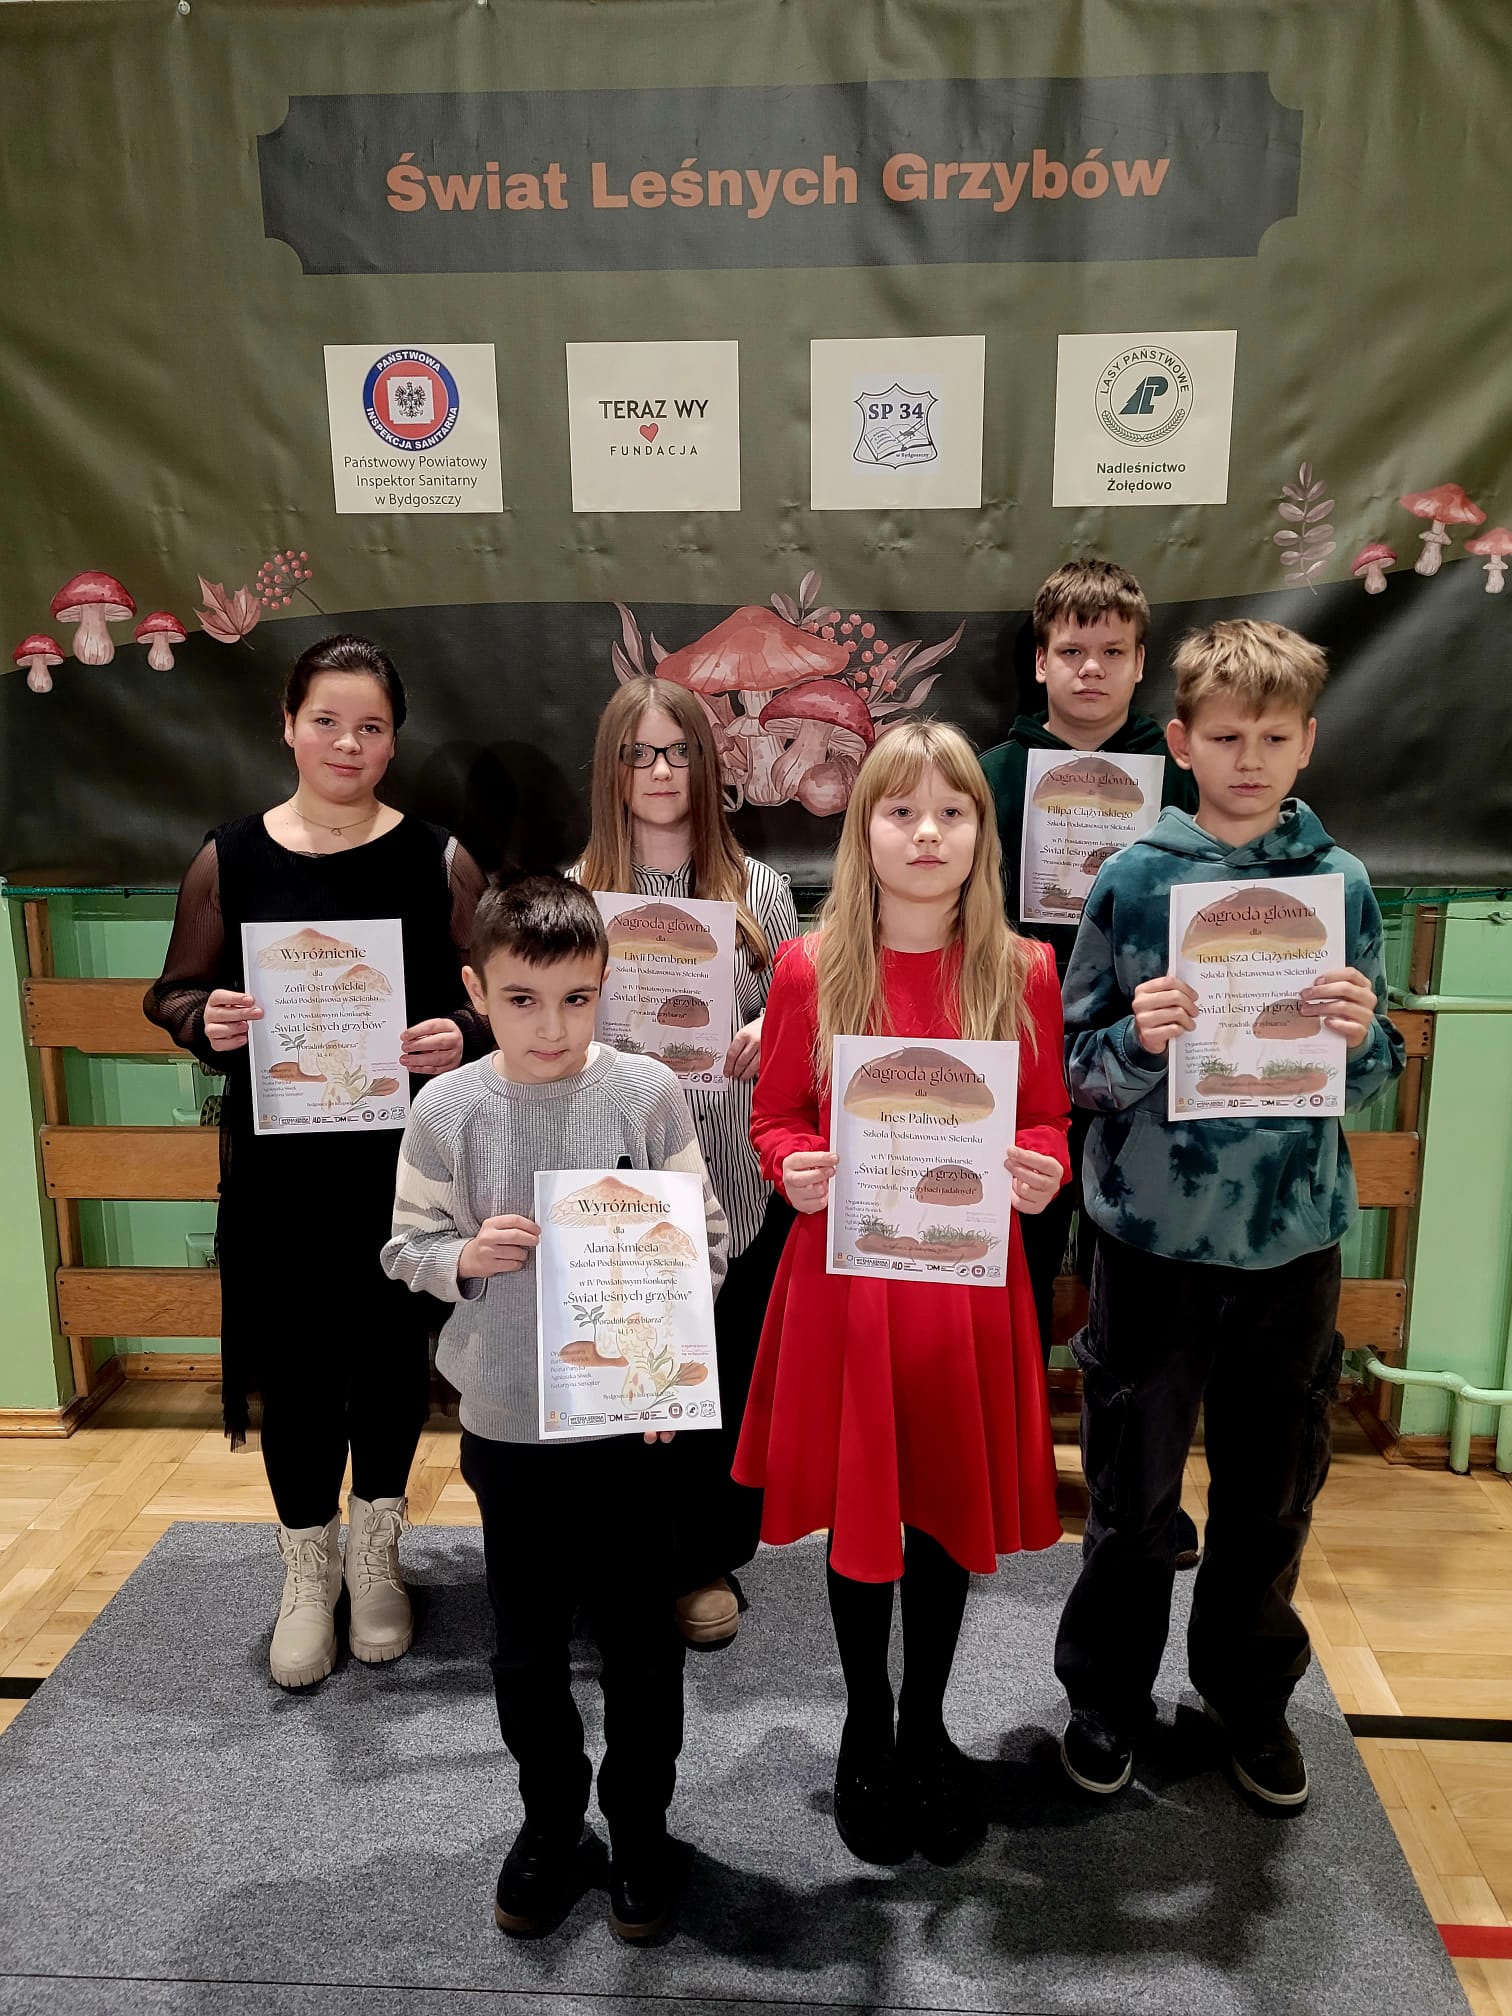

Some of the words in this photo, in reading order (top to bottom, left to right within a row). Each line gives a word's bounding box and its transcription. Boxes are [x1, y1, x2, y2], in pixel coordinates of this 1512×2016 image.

[385, 152, 569, 212] Świat
[591, 155, 858, 219] Leśnych
[882, 147, 1170, 213] Grzybów
[376, 351, 441, 372] PAŃSTWOWA
[1100, 362, 1121, 395] LASY
[1122, 347, 1190, 393] PAŃSTWOWE
[598, 399, 668, 419] TERAZ
[673, 399, 709, 419] WY
[868, 403, 894, 420] SP
[899, 402, 924, 420] 34
[366, 407, 413, 450] INSPEKCJA
[415, 406, 458, 450] SANITARNA
[610, 445, 698, 457] FUNDACJA
[344, 455, 416, 470] Państwowy
[419, 455, 488, 470] Powiatowy
[1096, 461, 1186, 474] Nadleśnictwo
[356, 474, 415, 489] Inspektor
[418, 474, 478, 489] Sanitarny
[1107, 477, 1172, 493] Żołędowo
[375, 496, 386, 505] w
[389, 493, 462, 508] Bydgoszczy
[1197, 906, 1260, 926] Nagroda
[1263, 905, 1316, 925] główna
[614, 915, 665, 931] Nagroda
[666, 918, 711, 934] główna
[280, 947, 367, 962] Wyróżnienie
[647, 953, 697, 966] Dembront
[1197, 952, 1249, 965] Tomasza
[860, 1064, 926, 1084] Nagroda
[929, 1066, 986, 1087] główna
[914, 1089, 927, 1097] dla
[880, 1111, 906, 1123] Ines
[908, 1112, 961, 1128] Paliwody
[891, 1165, 933, 1179] leśnych
[578, 1198, 671, 1216] Wyróżnienie
[613, 1226, 625, 1235] dla
[583, 1242, 615, 1254] Alana
[617, 1242, 659, 1254] Kmiecia
[597, 1258, 645, 1268] Podstawowa
[601, 1290, 643, 1304] leśnych
